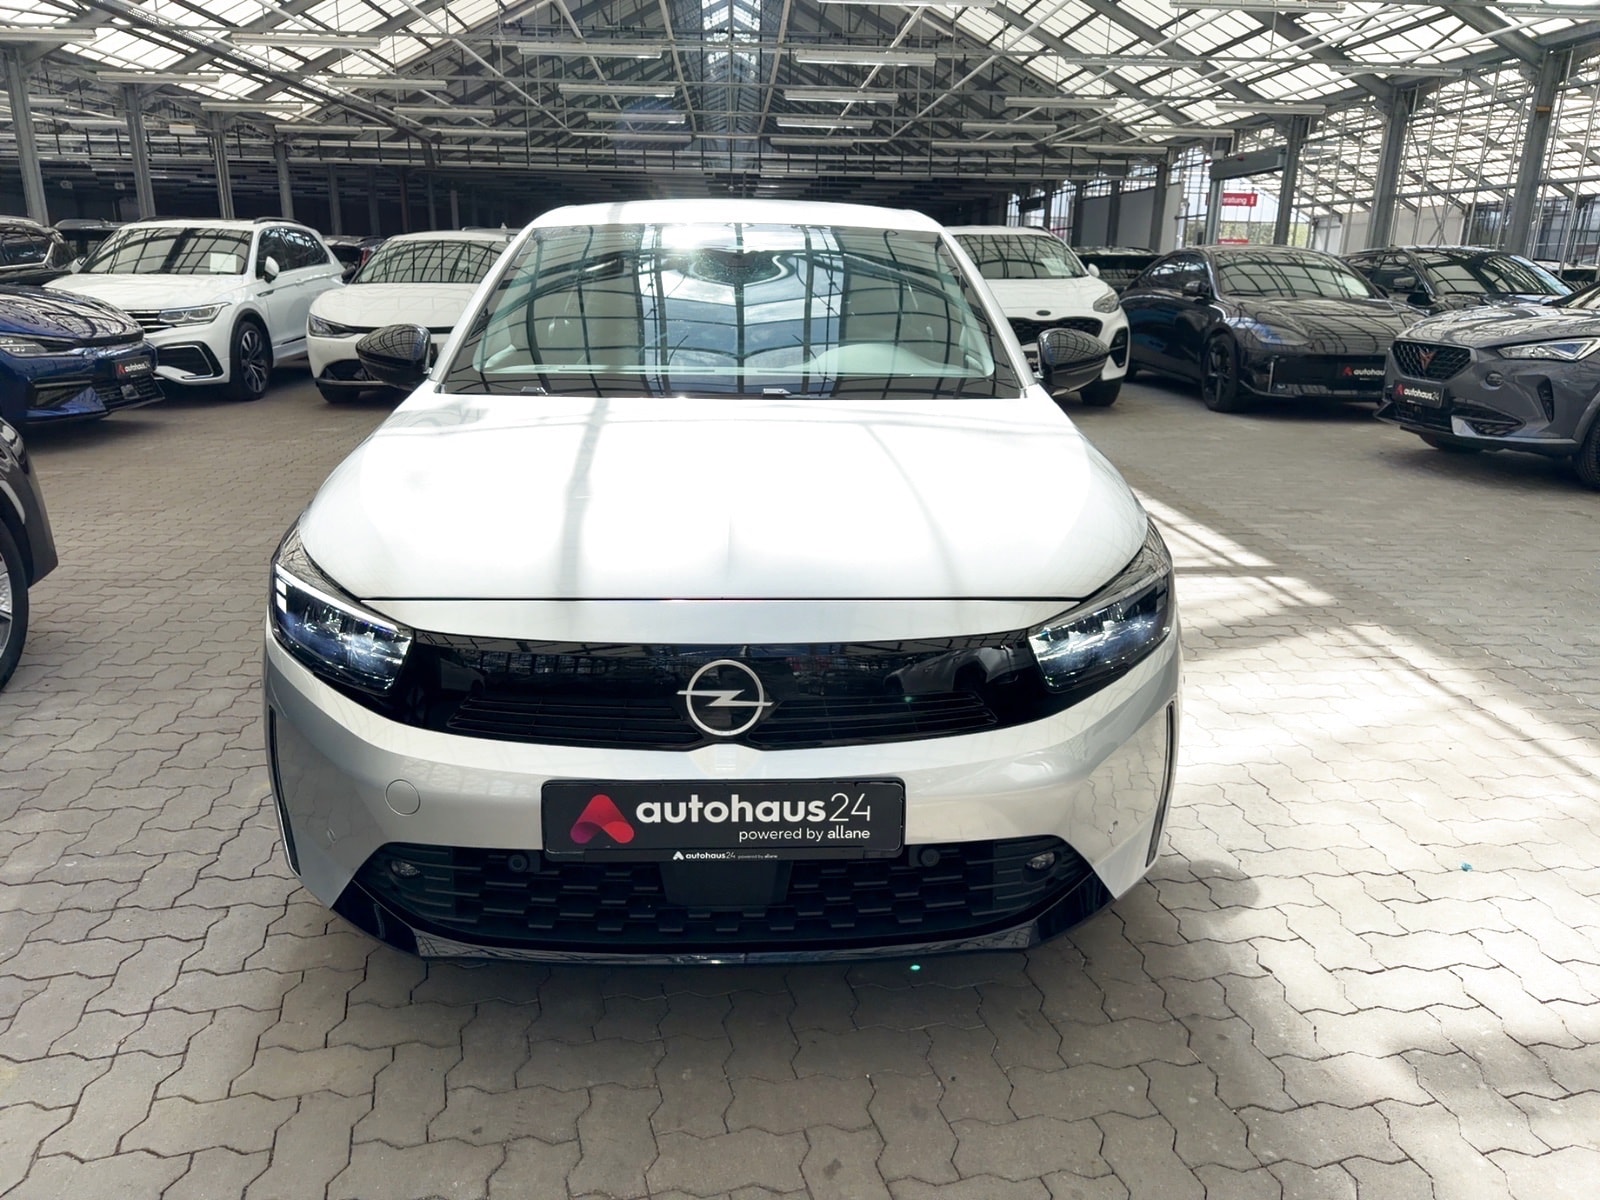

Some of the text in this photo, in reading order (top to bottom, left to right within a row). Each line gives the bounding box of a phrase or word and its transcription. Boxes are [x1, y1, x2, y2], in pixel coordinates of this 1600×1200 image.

[1353, 368, 1385, 376] autohau
[1403, 388, 1440, 401] autohaus24
[636, 793, 871, 823] autohaus24
[739, 825, 871, 843] powered by allane
[685, 851, 736, 860] autohaus24
